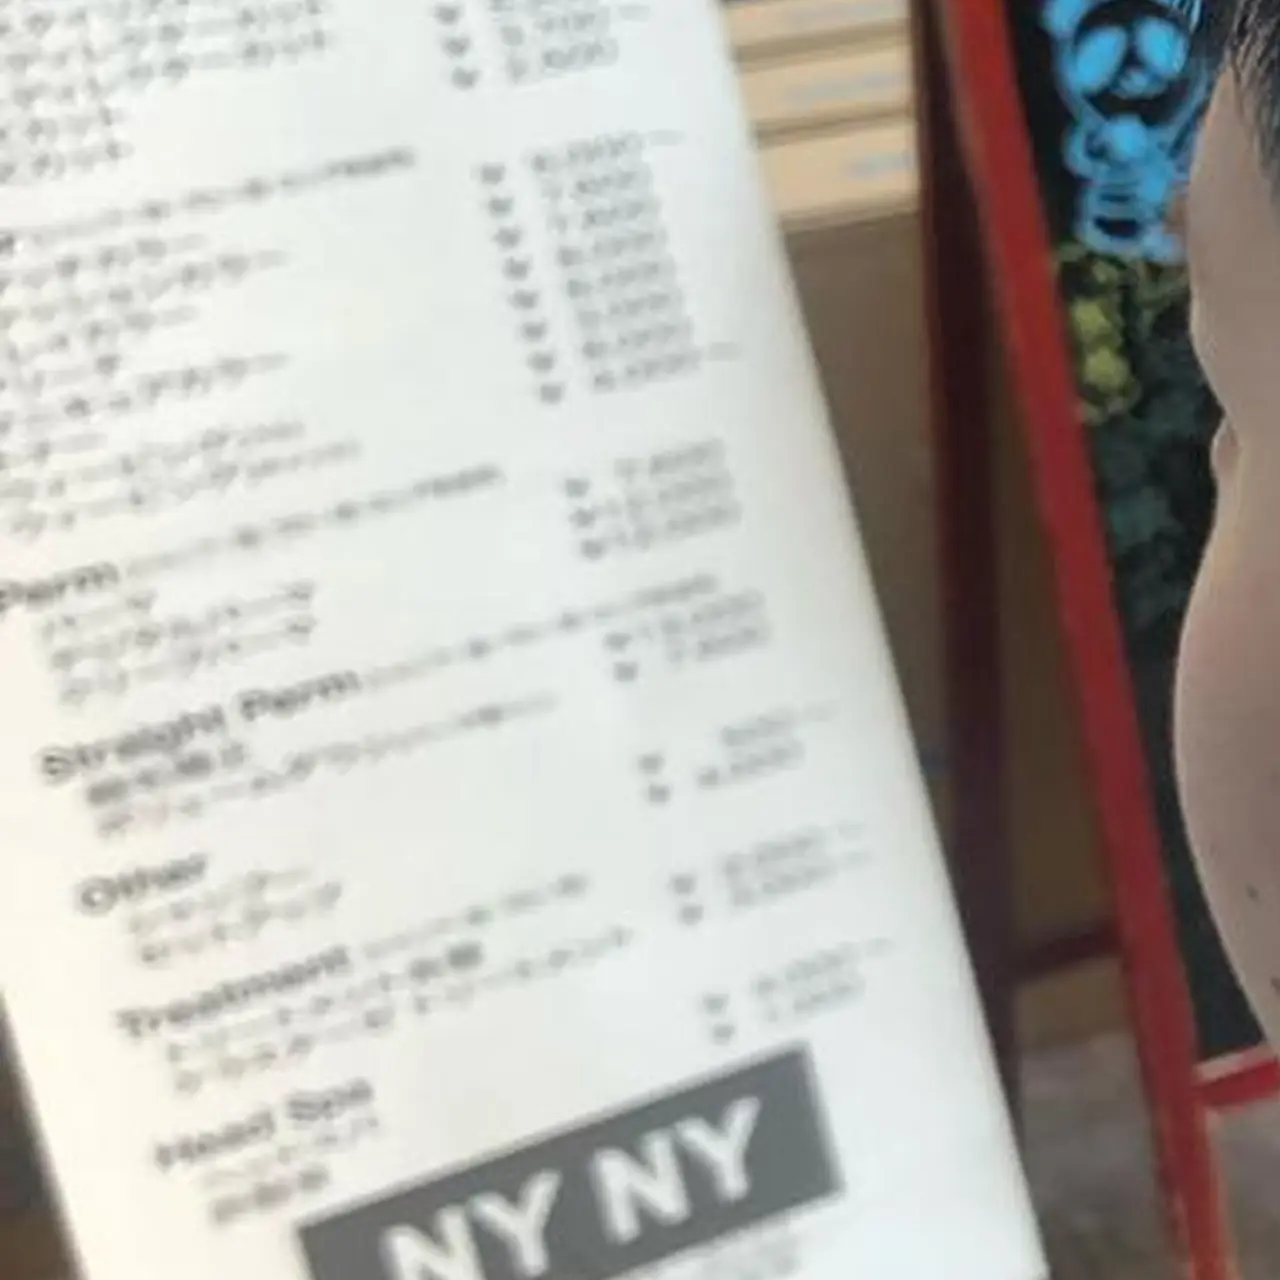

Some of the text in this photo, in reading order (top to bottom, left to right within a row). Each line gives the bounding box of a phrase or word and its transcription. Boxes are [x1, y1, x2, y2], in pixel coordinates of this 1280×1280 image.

[40, 705, 226, 782] Straight
[237, 671, 361, 722] Perm
[77, 853, 207, 915] Other
[117, 946, 350, 1034] Treatment
[590, 1095, 762, 1245] NY
